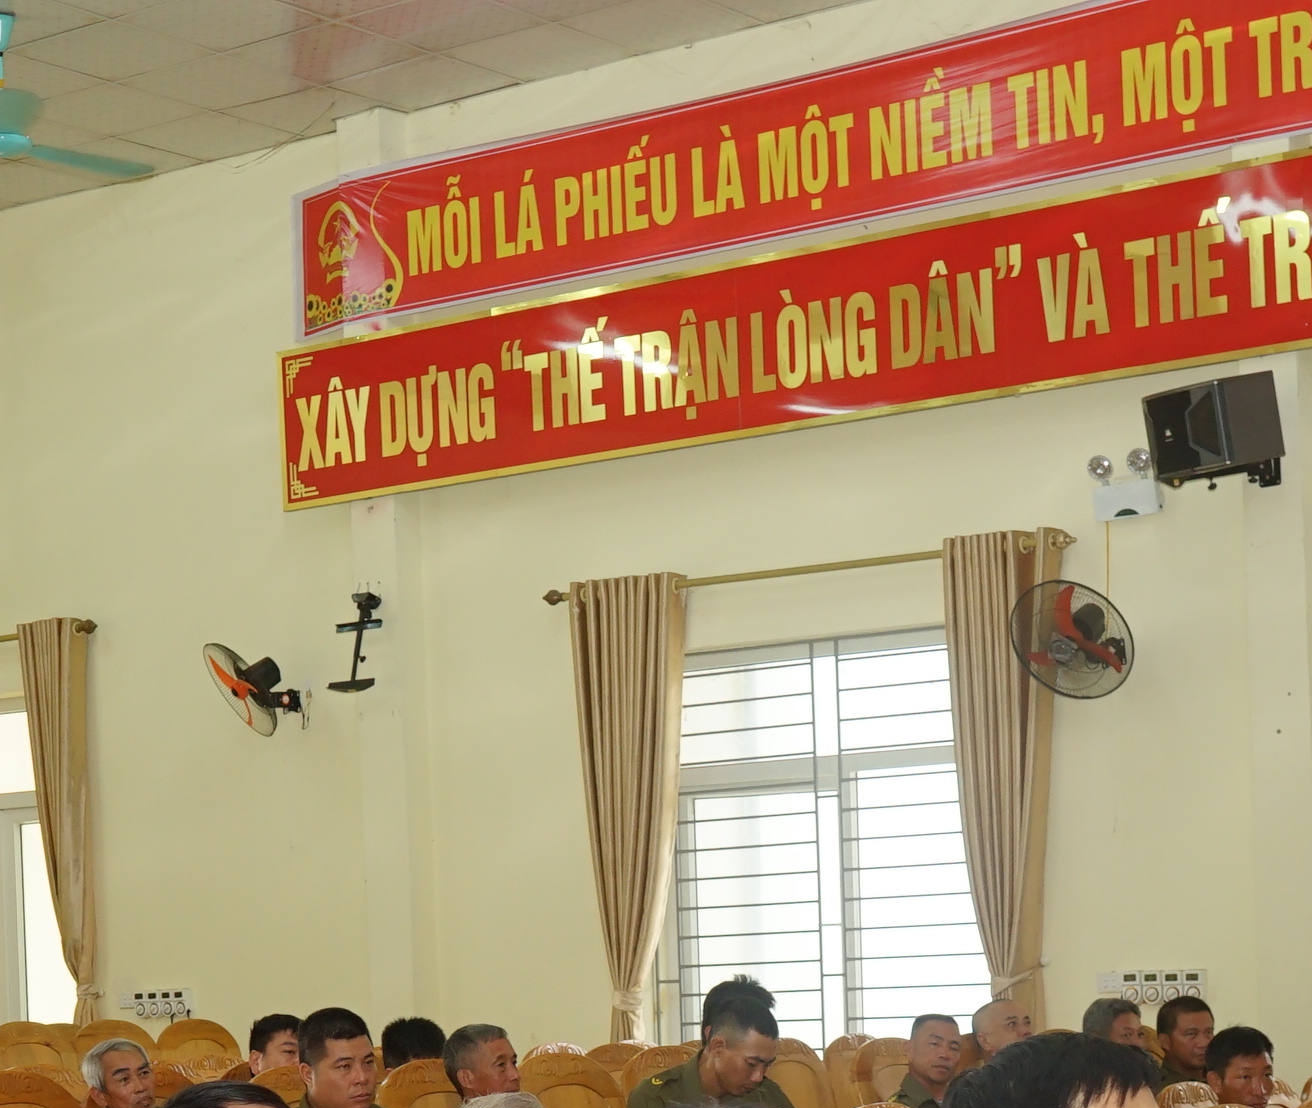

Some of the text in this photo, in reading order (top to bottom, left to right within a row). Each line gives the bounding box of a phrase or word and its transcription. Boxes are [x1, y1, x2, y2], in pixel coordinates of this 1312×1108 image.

[406, 174, 482, 276] MỖI
[493, 169, 543, 259] LÁ
[555, 135, 677, 244] PHIẾU
[691, 124, 743, 218] LÀ
[757, 105, 853, 202] MỘT
[868, 66, 995, 181] NIỀM
[1006, 59, 1104, 146] TIN,
[1121, 18, 1233, 133] MỘT
[296, 376, 371, 472] XÂY
[380, 363, 496, 468] DỰNG
[620, 308, 739, 420] TRẬN
[749, 289, 877, 394] LÒNG
[1037, 230, 1111, 343] VÀ
[1123, 195, 1231, 328] THẾ
